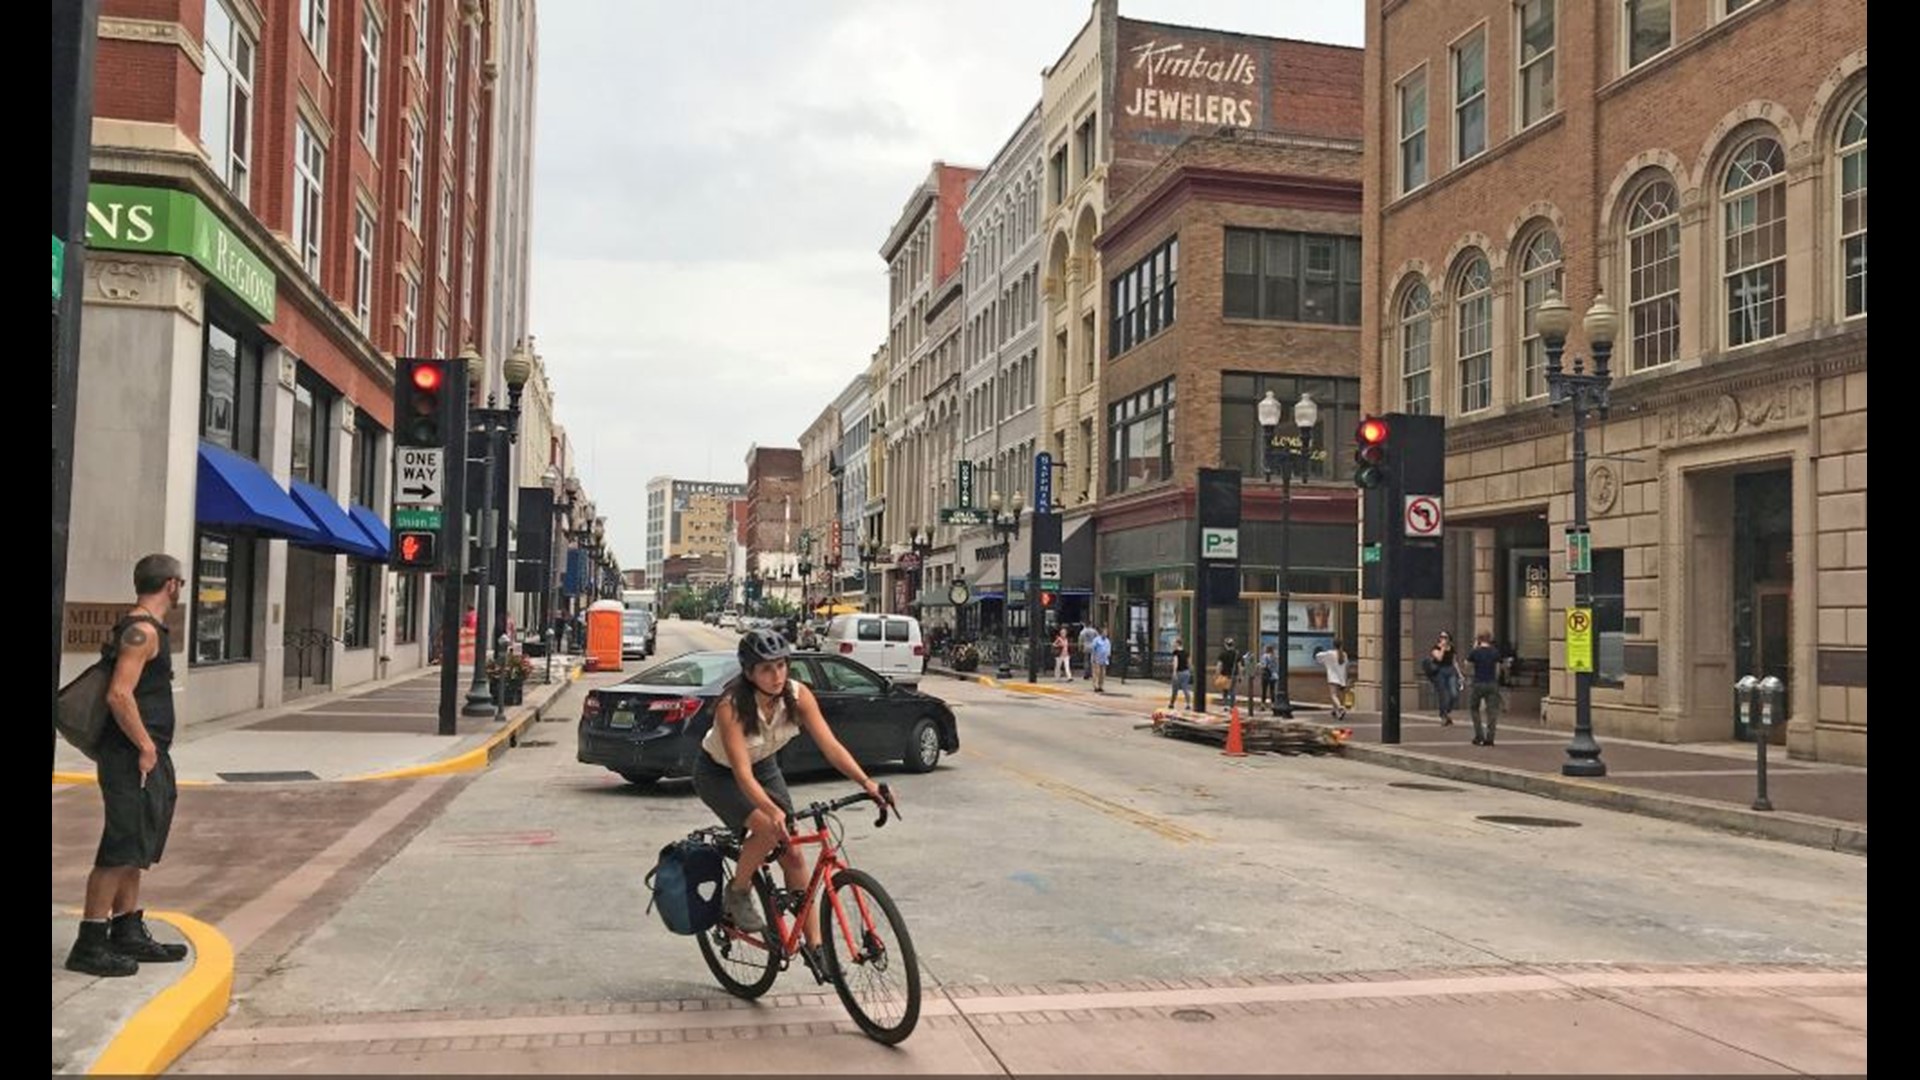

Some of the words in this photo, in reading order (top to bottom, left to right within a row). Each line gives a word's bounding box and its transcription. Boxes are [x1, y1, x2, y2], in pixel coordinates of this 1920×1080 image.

[1130, 40, 1257, 85] Kimball's
[1125, 87, 1253, 128] JEWELERS
[405, 452, 437, 466] ONE
[403, 467, 437, 481] WAY
[1526, 564, 1548, 580] fab
[1525, 580, 1548, 597] lab
